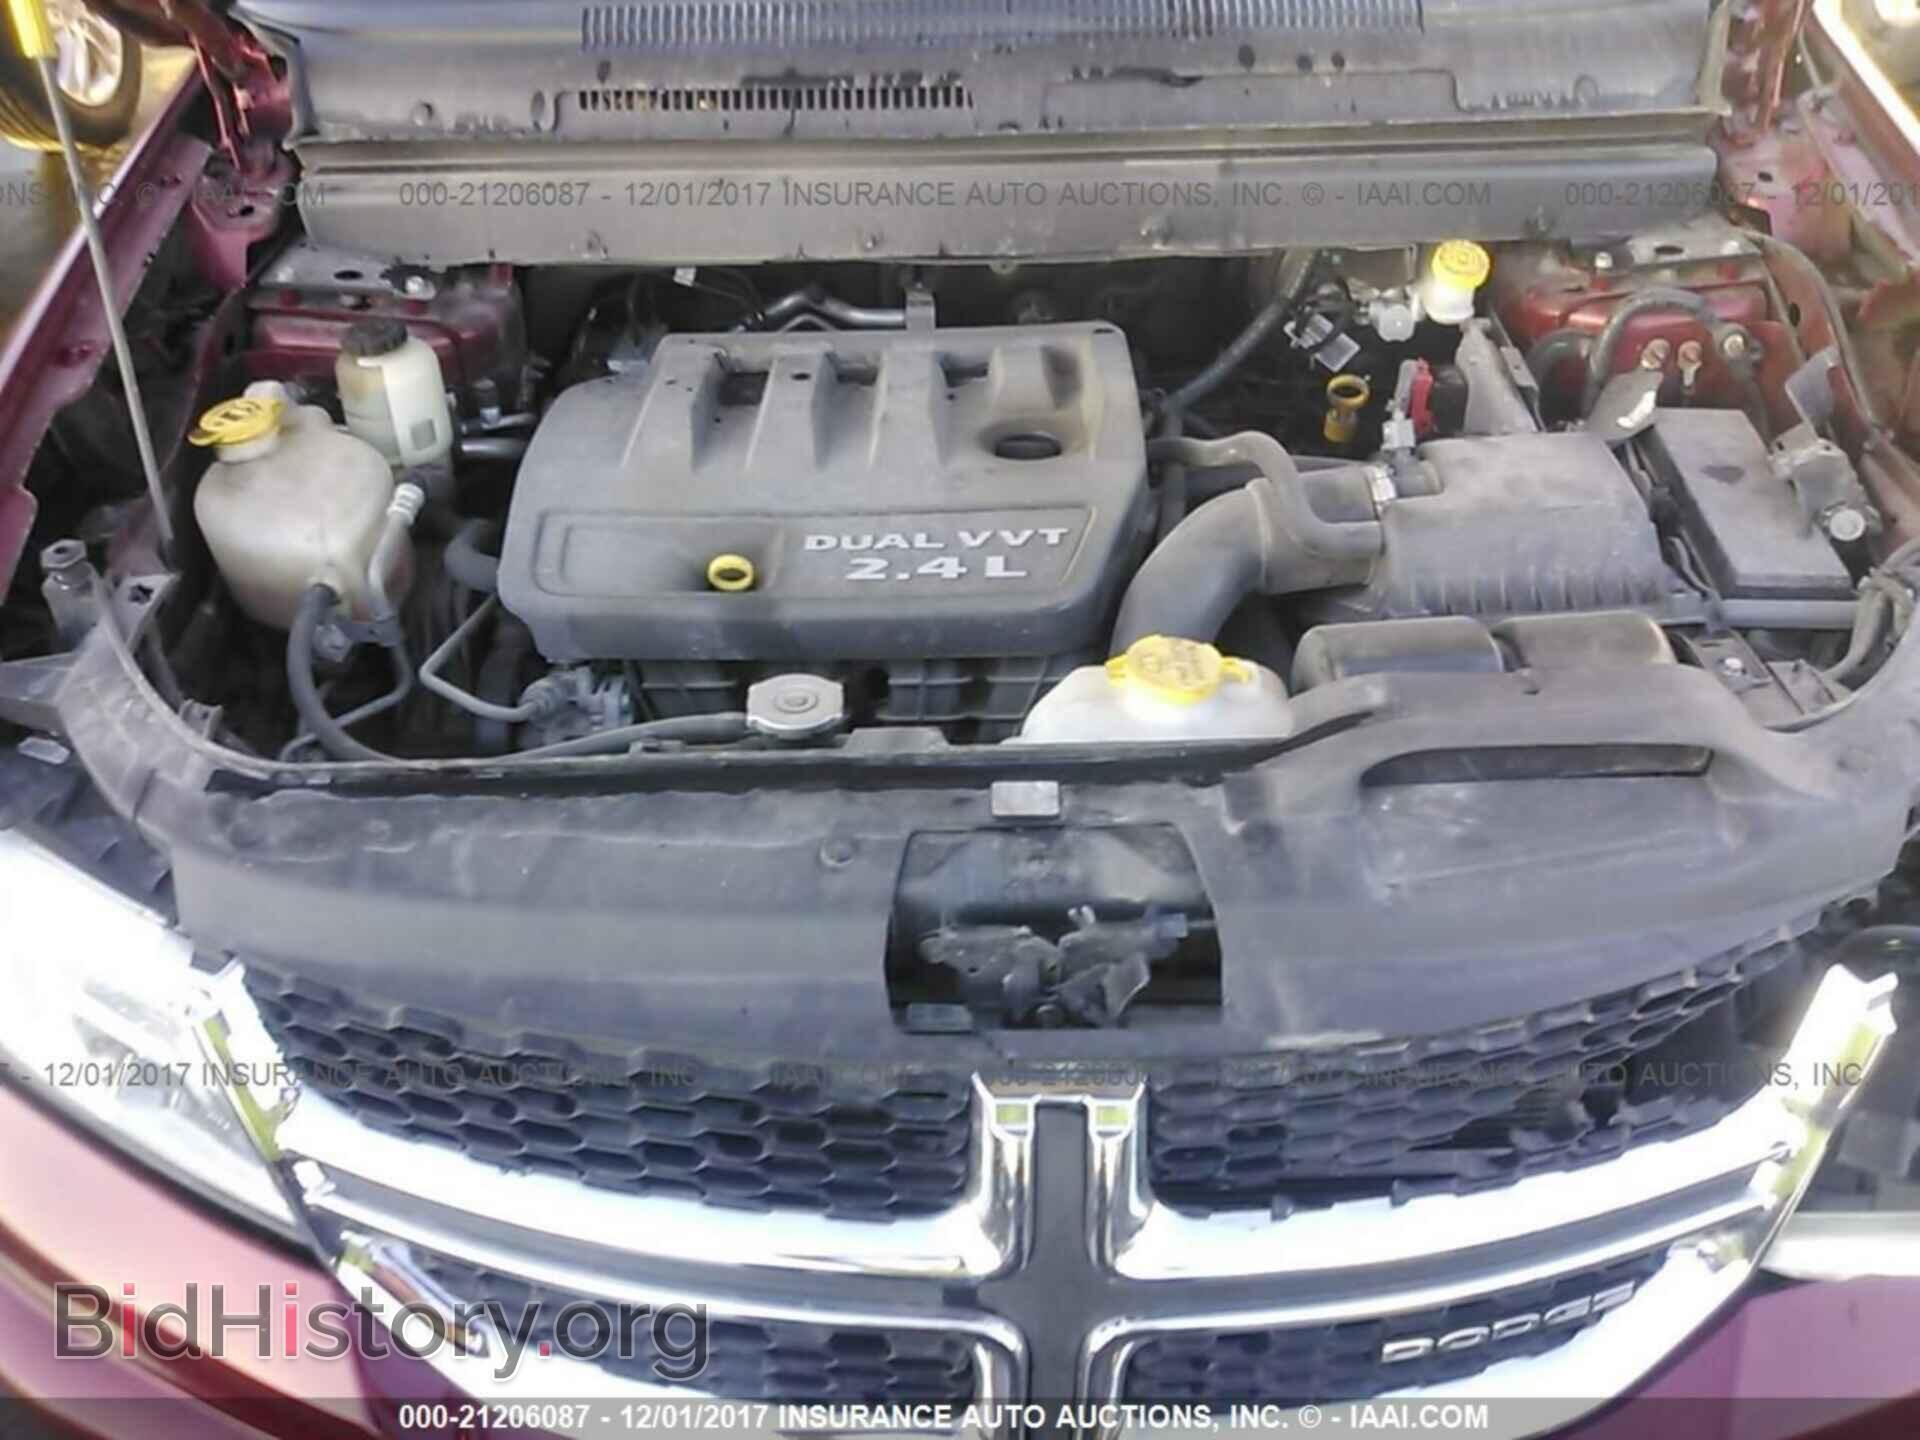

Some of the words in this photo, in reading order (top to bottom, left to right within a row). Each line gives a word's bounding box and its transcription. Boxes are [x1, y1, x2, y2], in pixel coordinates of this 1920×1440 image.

[804, 532, 945, 550] DUAL
[957, 528, 1069, 547] VVT
[1381, 1280, 1636, 1363] DODGE
